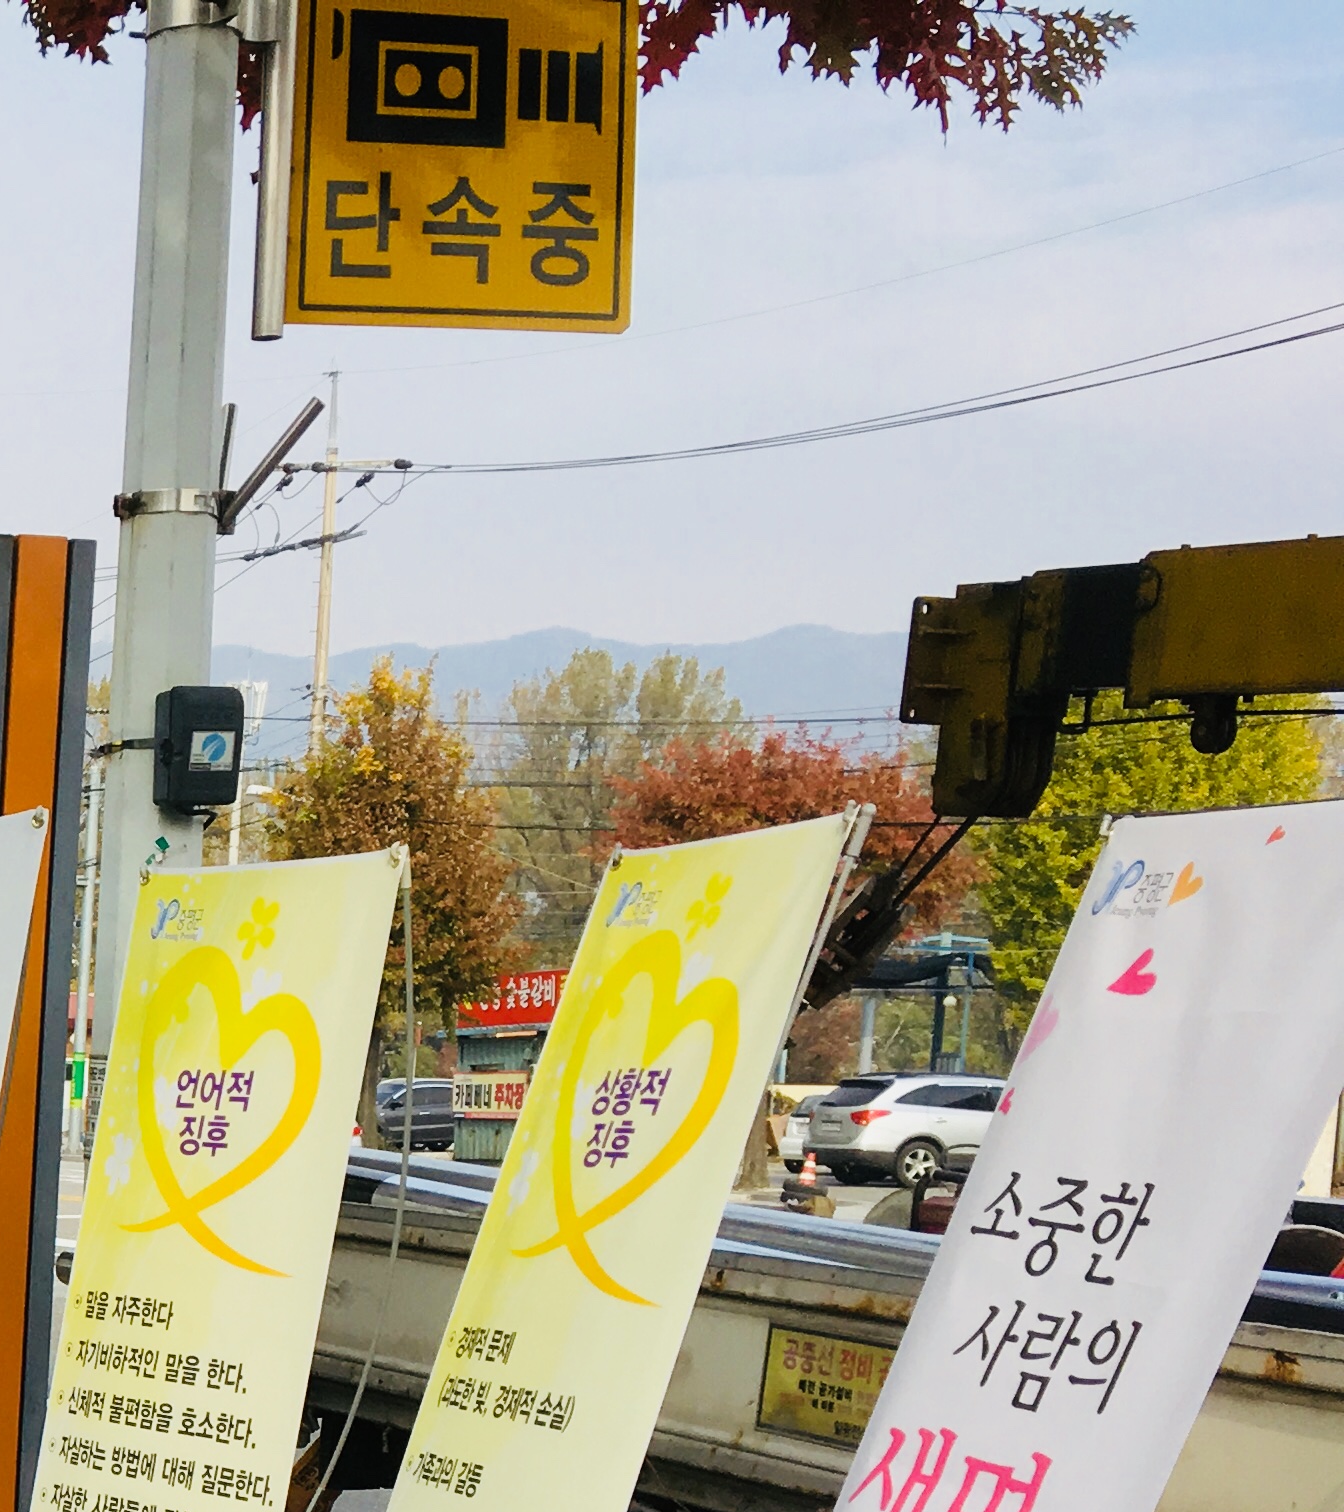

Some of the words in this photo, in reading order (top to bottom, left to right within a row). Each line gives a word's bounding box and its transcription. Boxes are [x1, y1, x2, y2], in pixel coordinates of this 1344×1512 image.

[324, 170, 600, 287] 단속중
[175, 1068, 254, 1113] 언어적
[591, 1068, 672, 1116] 상황적
[178, 1115, 231, 1156] 징후
[583, 1120, 636, 1168] 징후
[971, 1171, 1155, 1286] 소중한
[85, 1291, 109, 1321] 말을
[112, 1296, 174, 1331] 자주한다
[76, 1340, 159, 1379] 자기비하적인
[165, 1354, 200, 1387] 말을
[207, 1359, 247, 1395] 한다.
[455, 1327, 490, 1361] 경제적
[485, 1330, 517, 1365] 문제
[953, 1300, 1144, 1415] 사람의
[68, 1387, 106, 1421] 신체적
[109, 1395, 173, 1434] 불편함을
[178, 1408, 256, 1450] 호소한다.
[492, 1386, 538, 1424] 경제적
[534, 1393, 575, 1432] 손실)
[59, 1436, 106, 1471] 자살하는
[111, 1447, 157, 1483] 방법에
[162, 1458, 196, 1491] 대해
[201, 1465, 273, 1507] 질문한다.
[413, 1453, 459, 1492] 가족과의
[454, 1462, 484, 1499] 갈등
